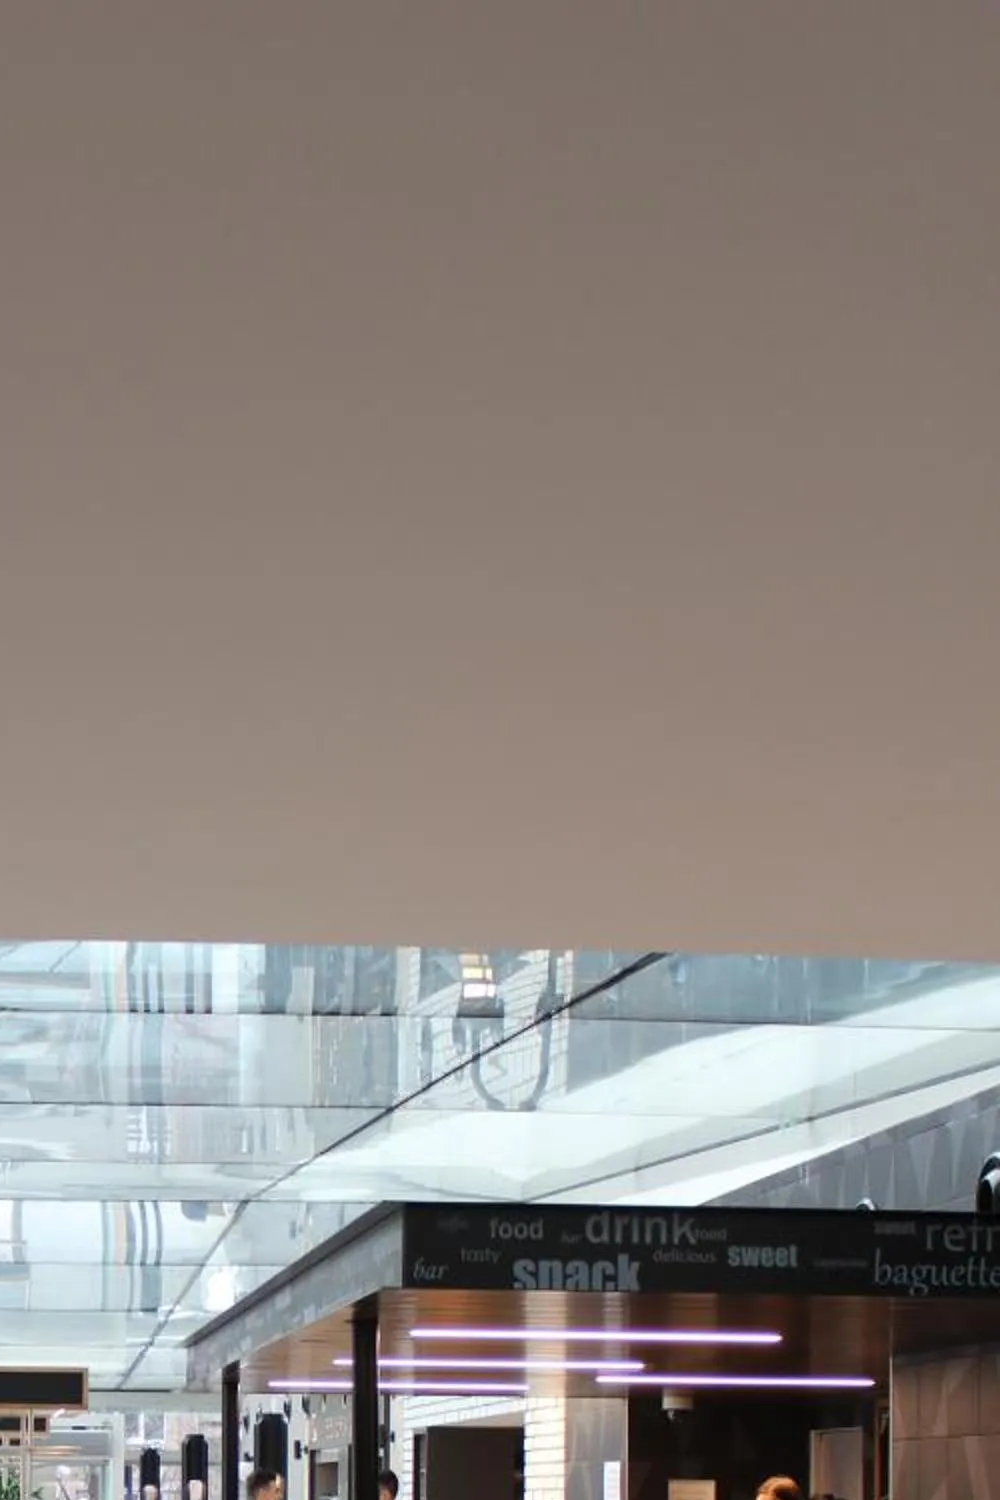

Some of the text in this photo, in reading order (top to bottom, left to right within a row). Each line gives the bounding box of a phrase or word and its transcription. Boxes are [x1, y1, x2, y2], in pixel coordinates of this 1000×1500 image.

[489, 1216, 544, 1240] food
[585, 1211, 697, 1246] drink
[460, 1247, 502, 1266] tasty
[652, 1247, 718, 1265] delicious
[727, 1243, 799, 1268] sweet
[412, 1256, 450, 1282] bar
[512, 1253, 642, 1291] snack
